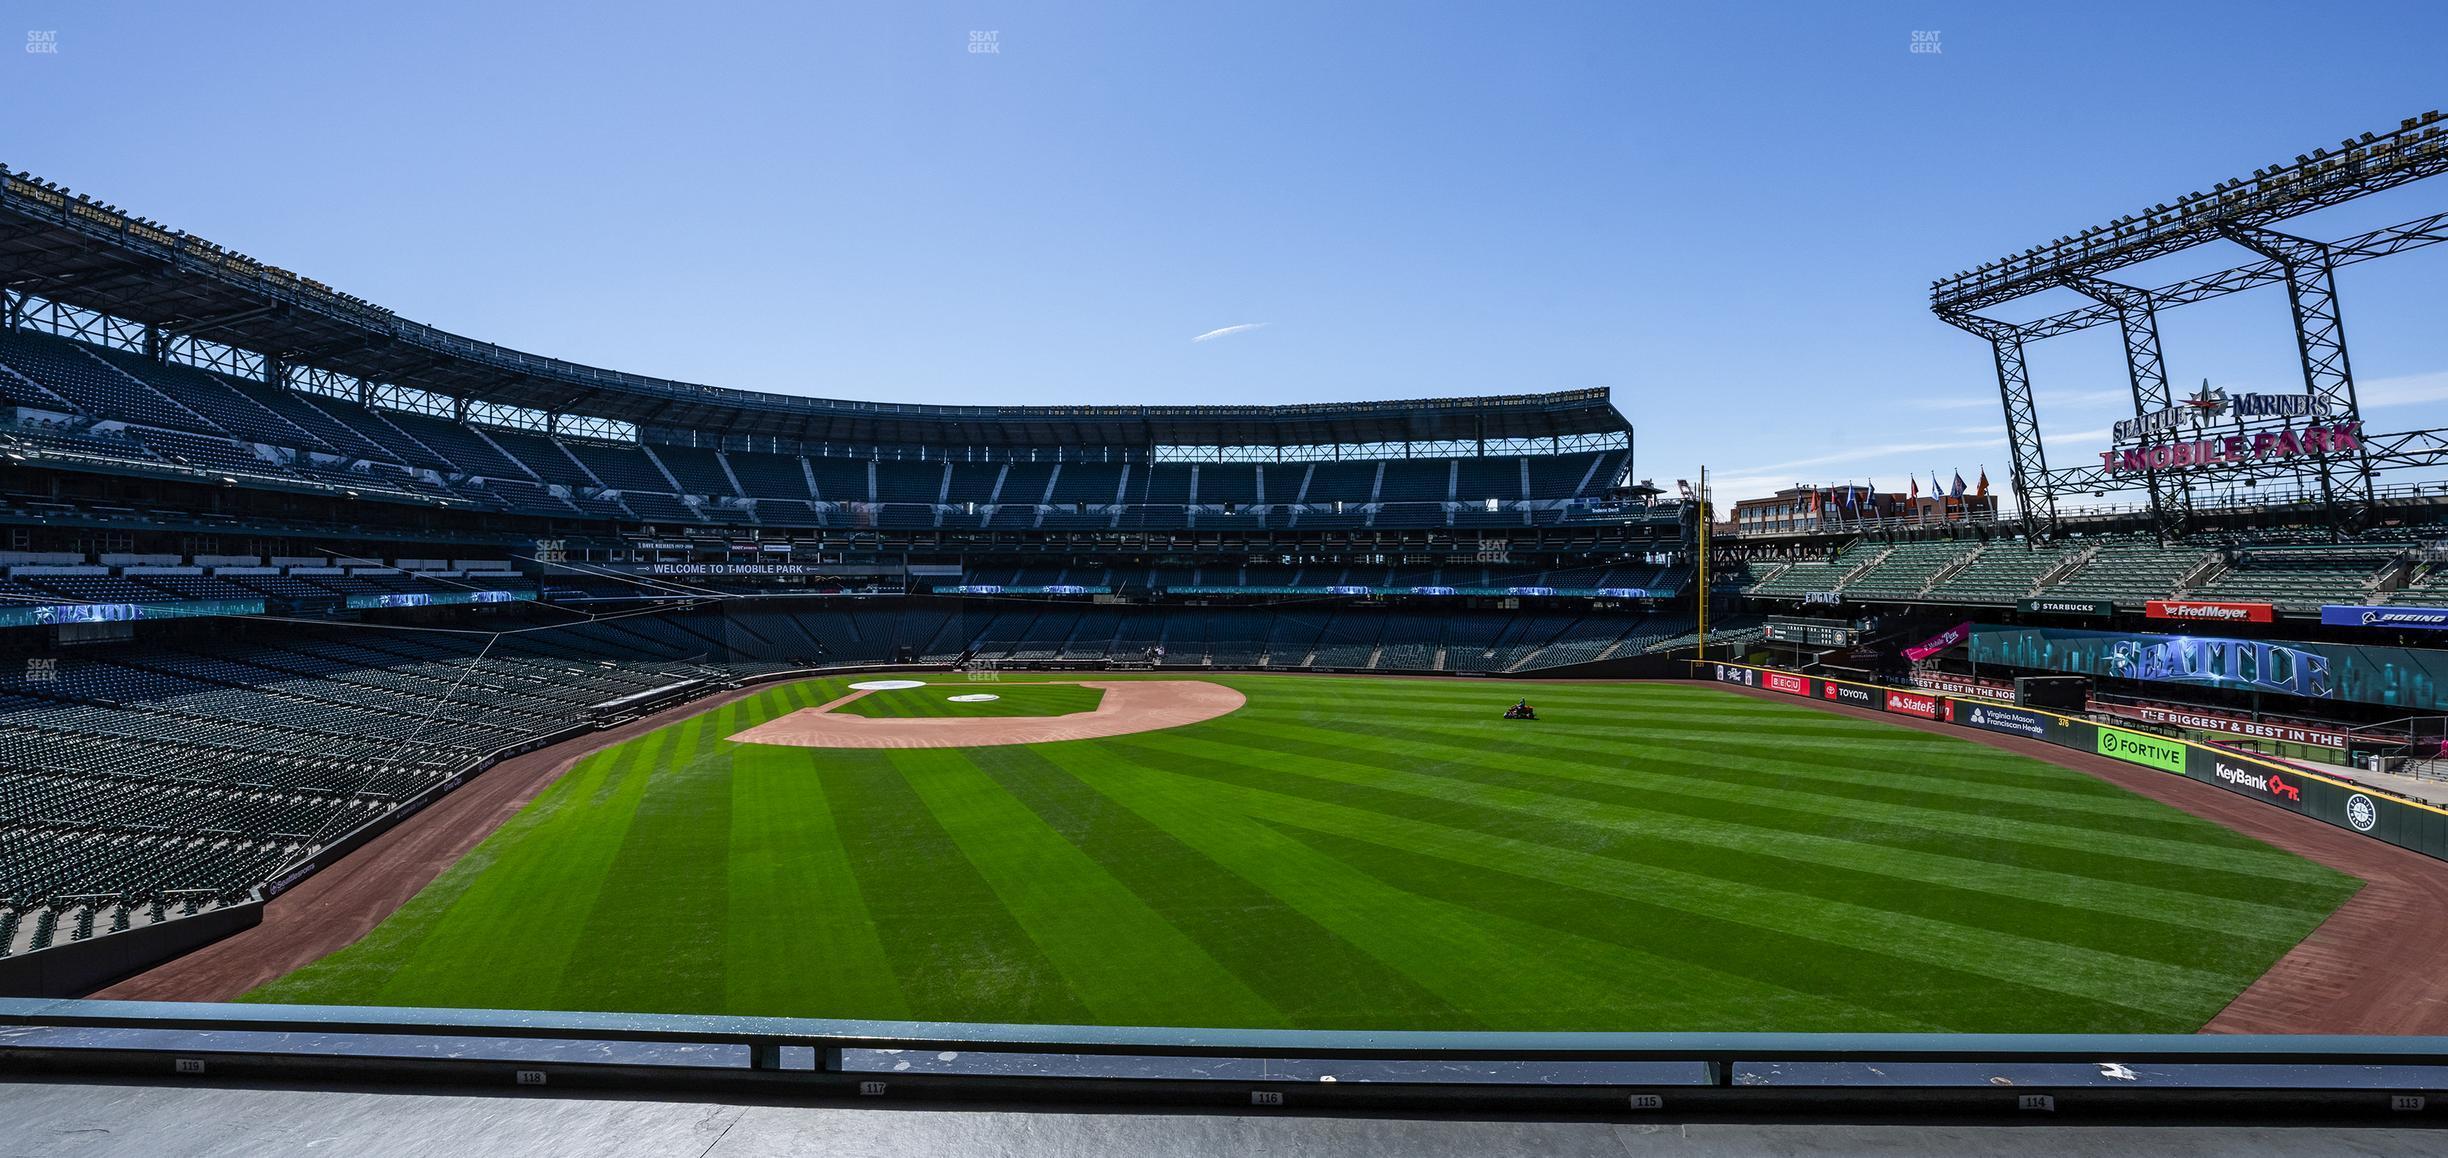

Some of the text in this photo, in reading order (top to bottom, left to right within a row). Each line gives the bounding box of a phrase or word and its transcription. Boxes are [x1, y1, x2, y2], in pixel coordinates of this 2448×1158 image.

[2113, 392, 2332, 443] SEATTLE MARINERS
[2099, 420, 2366, 474] T-MOBILE PARK
[654, 564, 803, 574] WELCOME TO T-MOBILE PARK
[2043, 603, 2094, 611] STARBUCKS
[2382, 613, 2447, 623] BOEING
[1774, 678, 1798, 689] BECU
[1839, 688, 1868, 701] TOYOTA
[1943, 684, 1963, 693] BEST
[1965, 686, 1975, 695] IN
[1977, 688, 1993, 697] THE
[1987, 710, 2035, 724] Virginia Mason
[1987, 718, 2043, 734] Franciscan Health
[2141, 709, 2344, 747] THE BIGGEST & BEST IN THE
[2120, 739, 2180, 764] FORTIVE
[2216, 762, 2268, 792] KeyBank
[183, 1061, 200, 1071] 119
[524, 1072, 541, 1082] 118
[867, 1083, 885, 1094] 117
[1259, 1093, 1278, 1103] 116
[1637, 1096, 1657, 1107] 115
[2027, 1096, 2046, 1107] 114
[2399, 1098, 2418, 1108] 113
